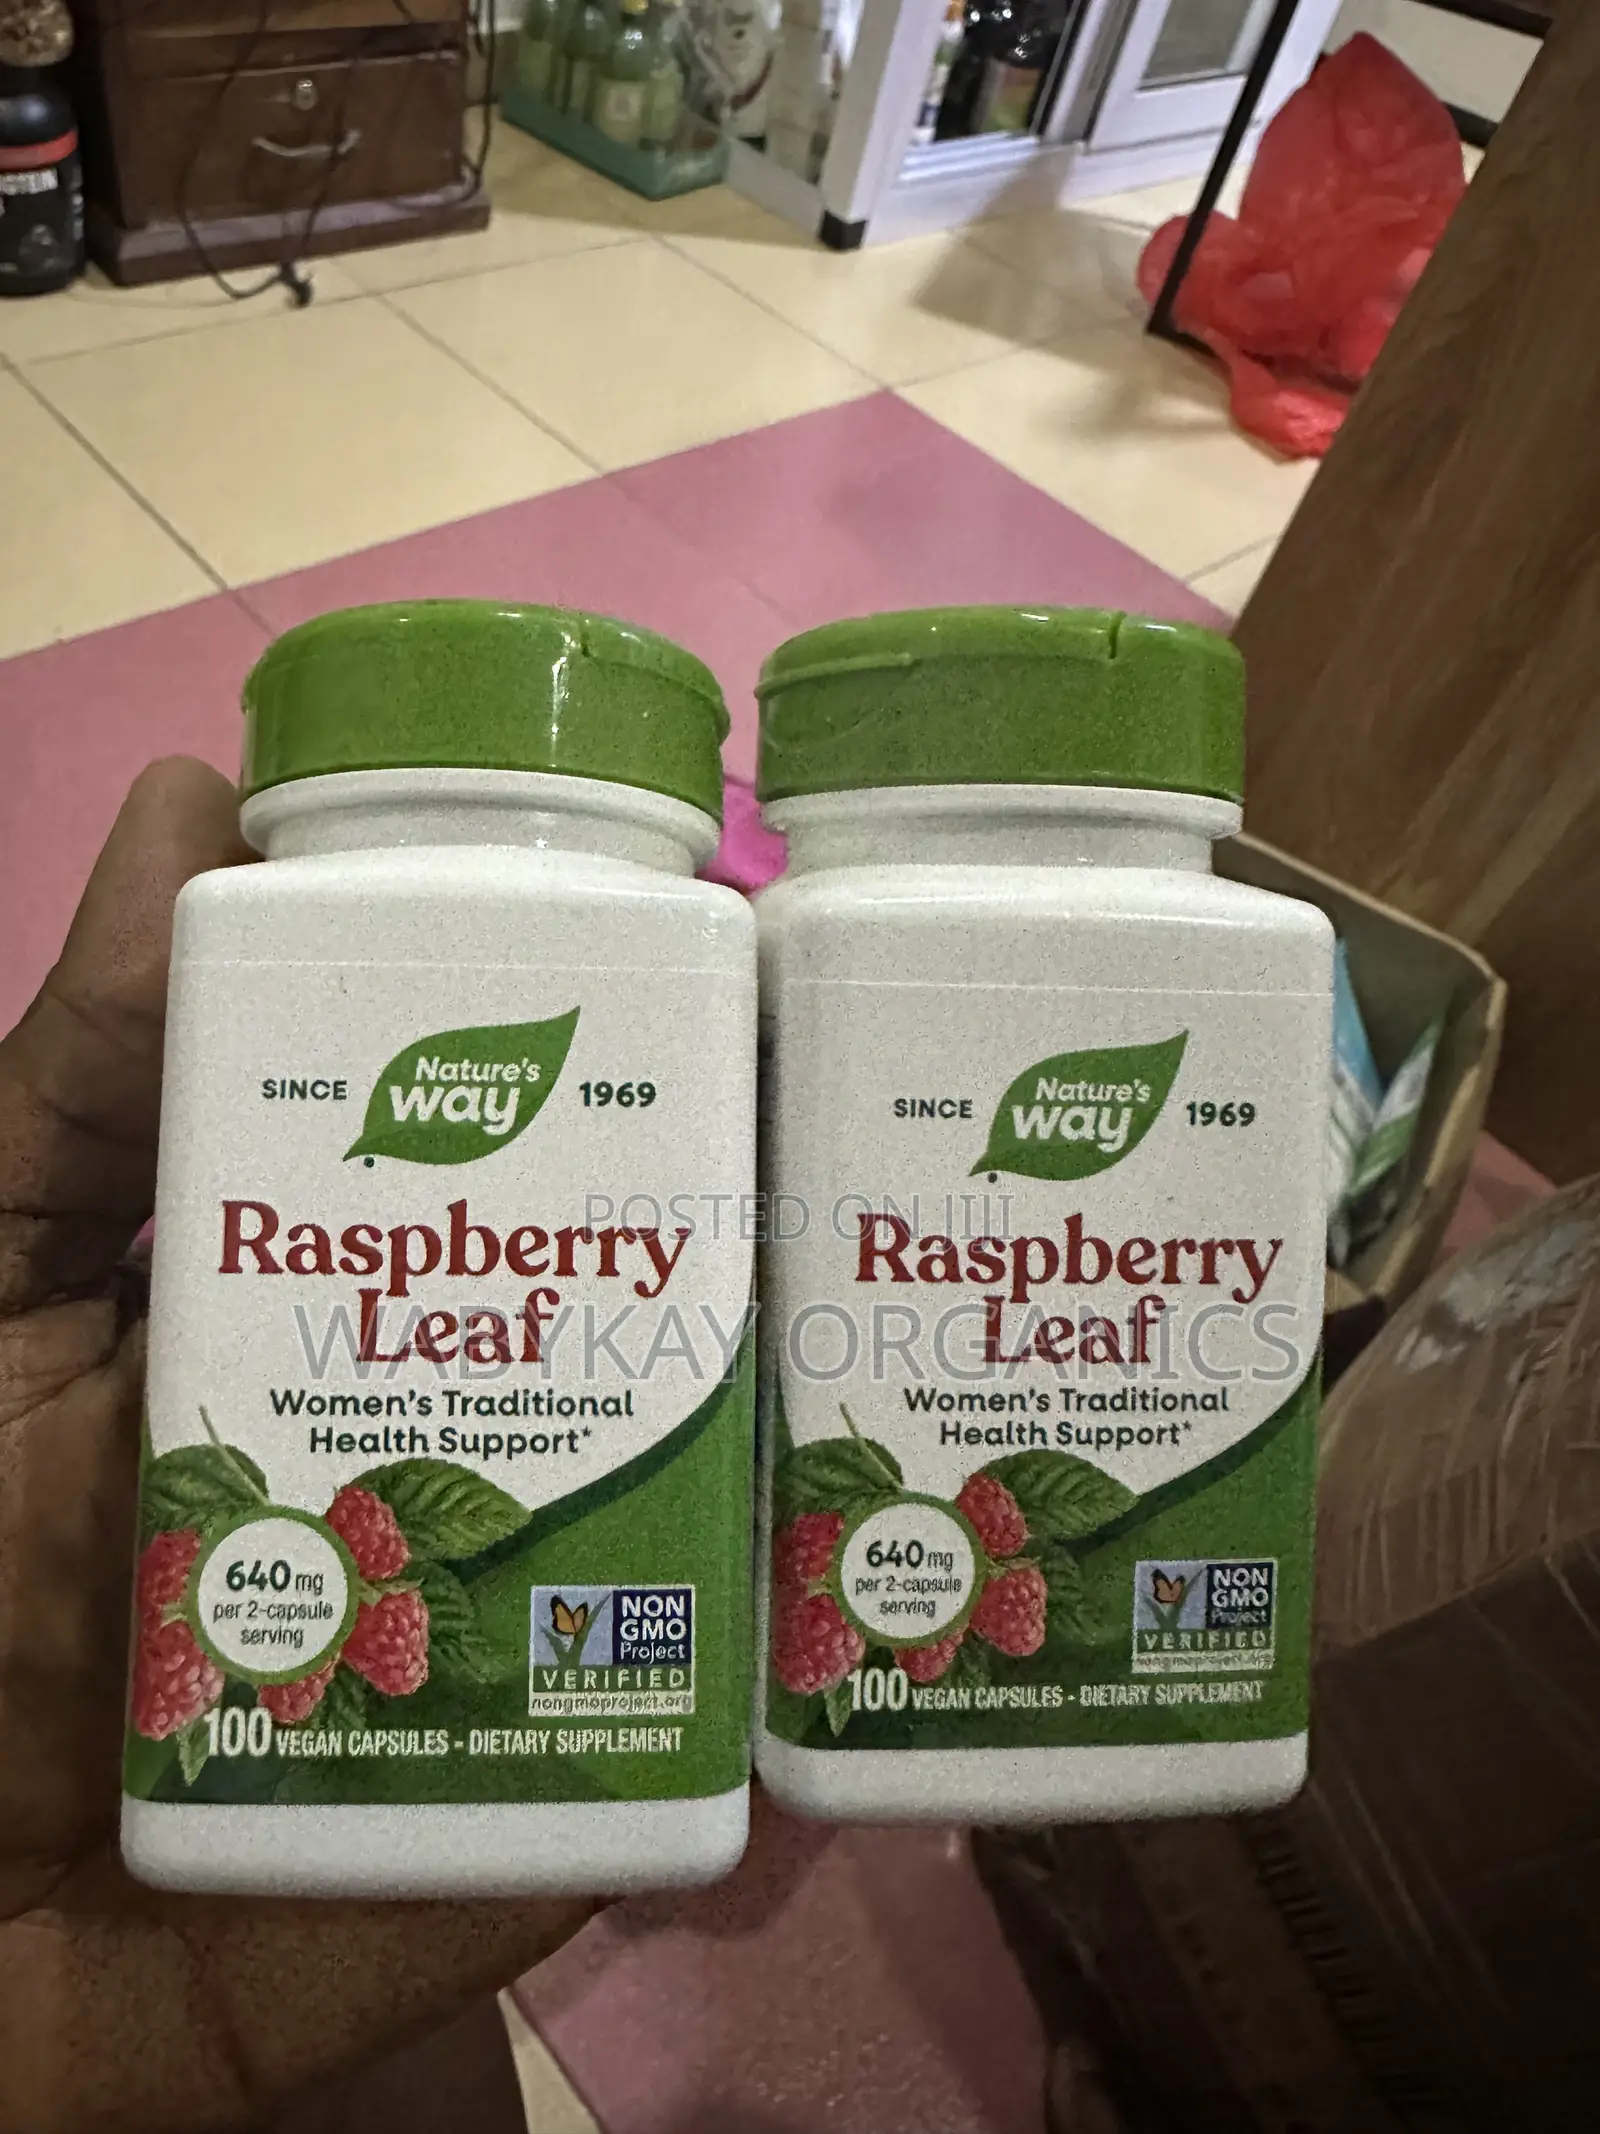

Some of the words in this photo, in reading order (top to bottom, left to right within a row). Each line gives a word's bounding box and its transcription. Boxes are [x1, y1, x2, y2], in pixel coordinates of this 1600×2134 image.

[415, 1056, 541, 1084] Nature's
[262, 1079, 347, 1101] SINCE
[580, 1081, 656, 1107] 1969
[1035, 1077, 1151, 1101] Nature's
[389, 1086, 521, 1135] way
[894, 1098, 973, 1119] SINCE
[1187, 1102, 1256, 1127] 1969
[1012, 1102, 1134, 1152] way
[217, 1199, 693, 1298] Raspberry
[855, 1213, 1284, 1304] Raspberry
[356, 1287, 561, 1363] Leaf
[981, 1295, 1167, 1364] Leaf
[269, 1389, 433, 1417] Women's
[441, 1389, 634, 1417] Traditional
[904, 1388, 1050, 1412] Women's
[1058, 1388, 1229, 1412] Traditional
[310, 1427, 430, 1454] Health
[940, 1422, 1048, 1446] Health
[865, 1540, 925, 1568] 640
[927, 1550, 954, 1571] mg
[226, 1560, 291, 1592] 640
[295, 1570, 324, 1596] mg
[855, 1577, 882, 1595] per
[1213, 1567, 1269, 1587] NON
[621, 1595, 686, 1618] NON
[1211, 1587, 1269, 1608] GMO
[213, 1602, 243, 1621] per
[246, 1601, 334, 1621] 2-capsule
[240, 1627, 304, 1649] serving
[619, 1618, 688, 1641] GMO
[1144, 1630, 1266, 1650] VERIFIED
[620, 1641, 686, 1664] Project
[542, 1668, 686, 1690] VERIFIED
[847, 1668, 908, 1712] 100
[911, 1687, 971, 1711] VEGAN
[974, 1685, 1063, 1709] CAPSULES
[1080, 1683, 1150, 1707] DIETARY
[1155, 1680, 1265, 1705] SUPPLEMENT
[202, 1707, 272, 1758] 100
[275, 1730, 343, 1757] VEGAN
[348, 1729, 450, 1756] CAPSULES
[469, 1727, 551, 1755] DIETARY
[556, 1726, 685, 1755] SUPPLEMENT
